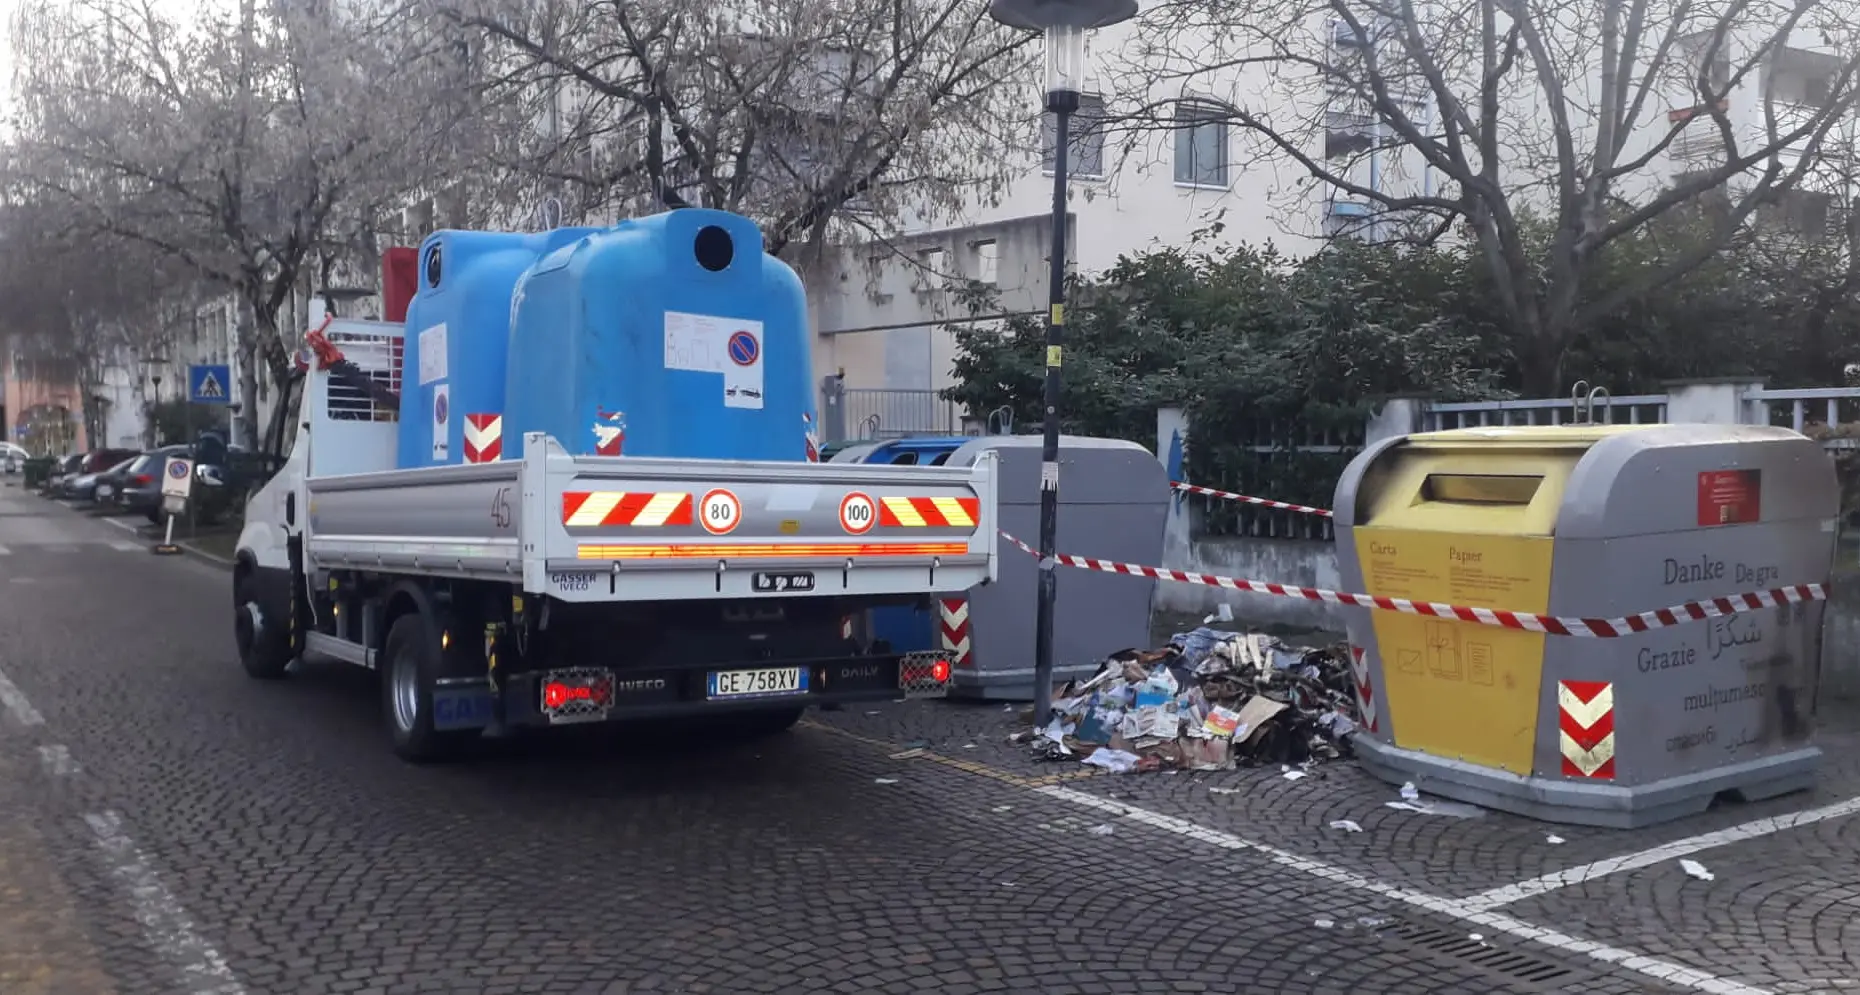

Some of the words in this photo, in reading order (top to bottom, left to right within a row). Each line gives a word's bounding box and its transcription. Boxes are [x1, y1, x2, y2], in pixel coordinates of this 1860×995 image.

[490, 487, 512, 528] 45
[710, 502, 731, 520] 80
[847, 504, 869, 521] 100
[1369, 540, 1398, 556] Carta
[1449, 546, 1482, 564] Papier
[551, 572, 597, 584] GASSER
[1663, 554, 1725, 586] Danke
[560, 582, 588, 592] IVECO
[1637, 641, 1696, 673] Grazie
[841, 664, 879, 679] DAILY
[619, 679, 666, 692] IVECO
[719, 672, 741, 693] GE
[746, 669, 797, 691] 758XV
